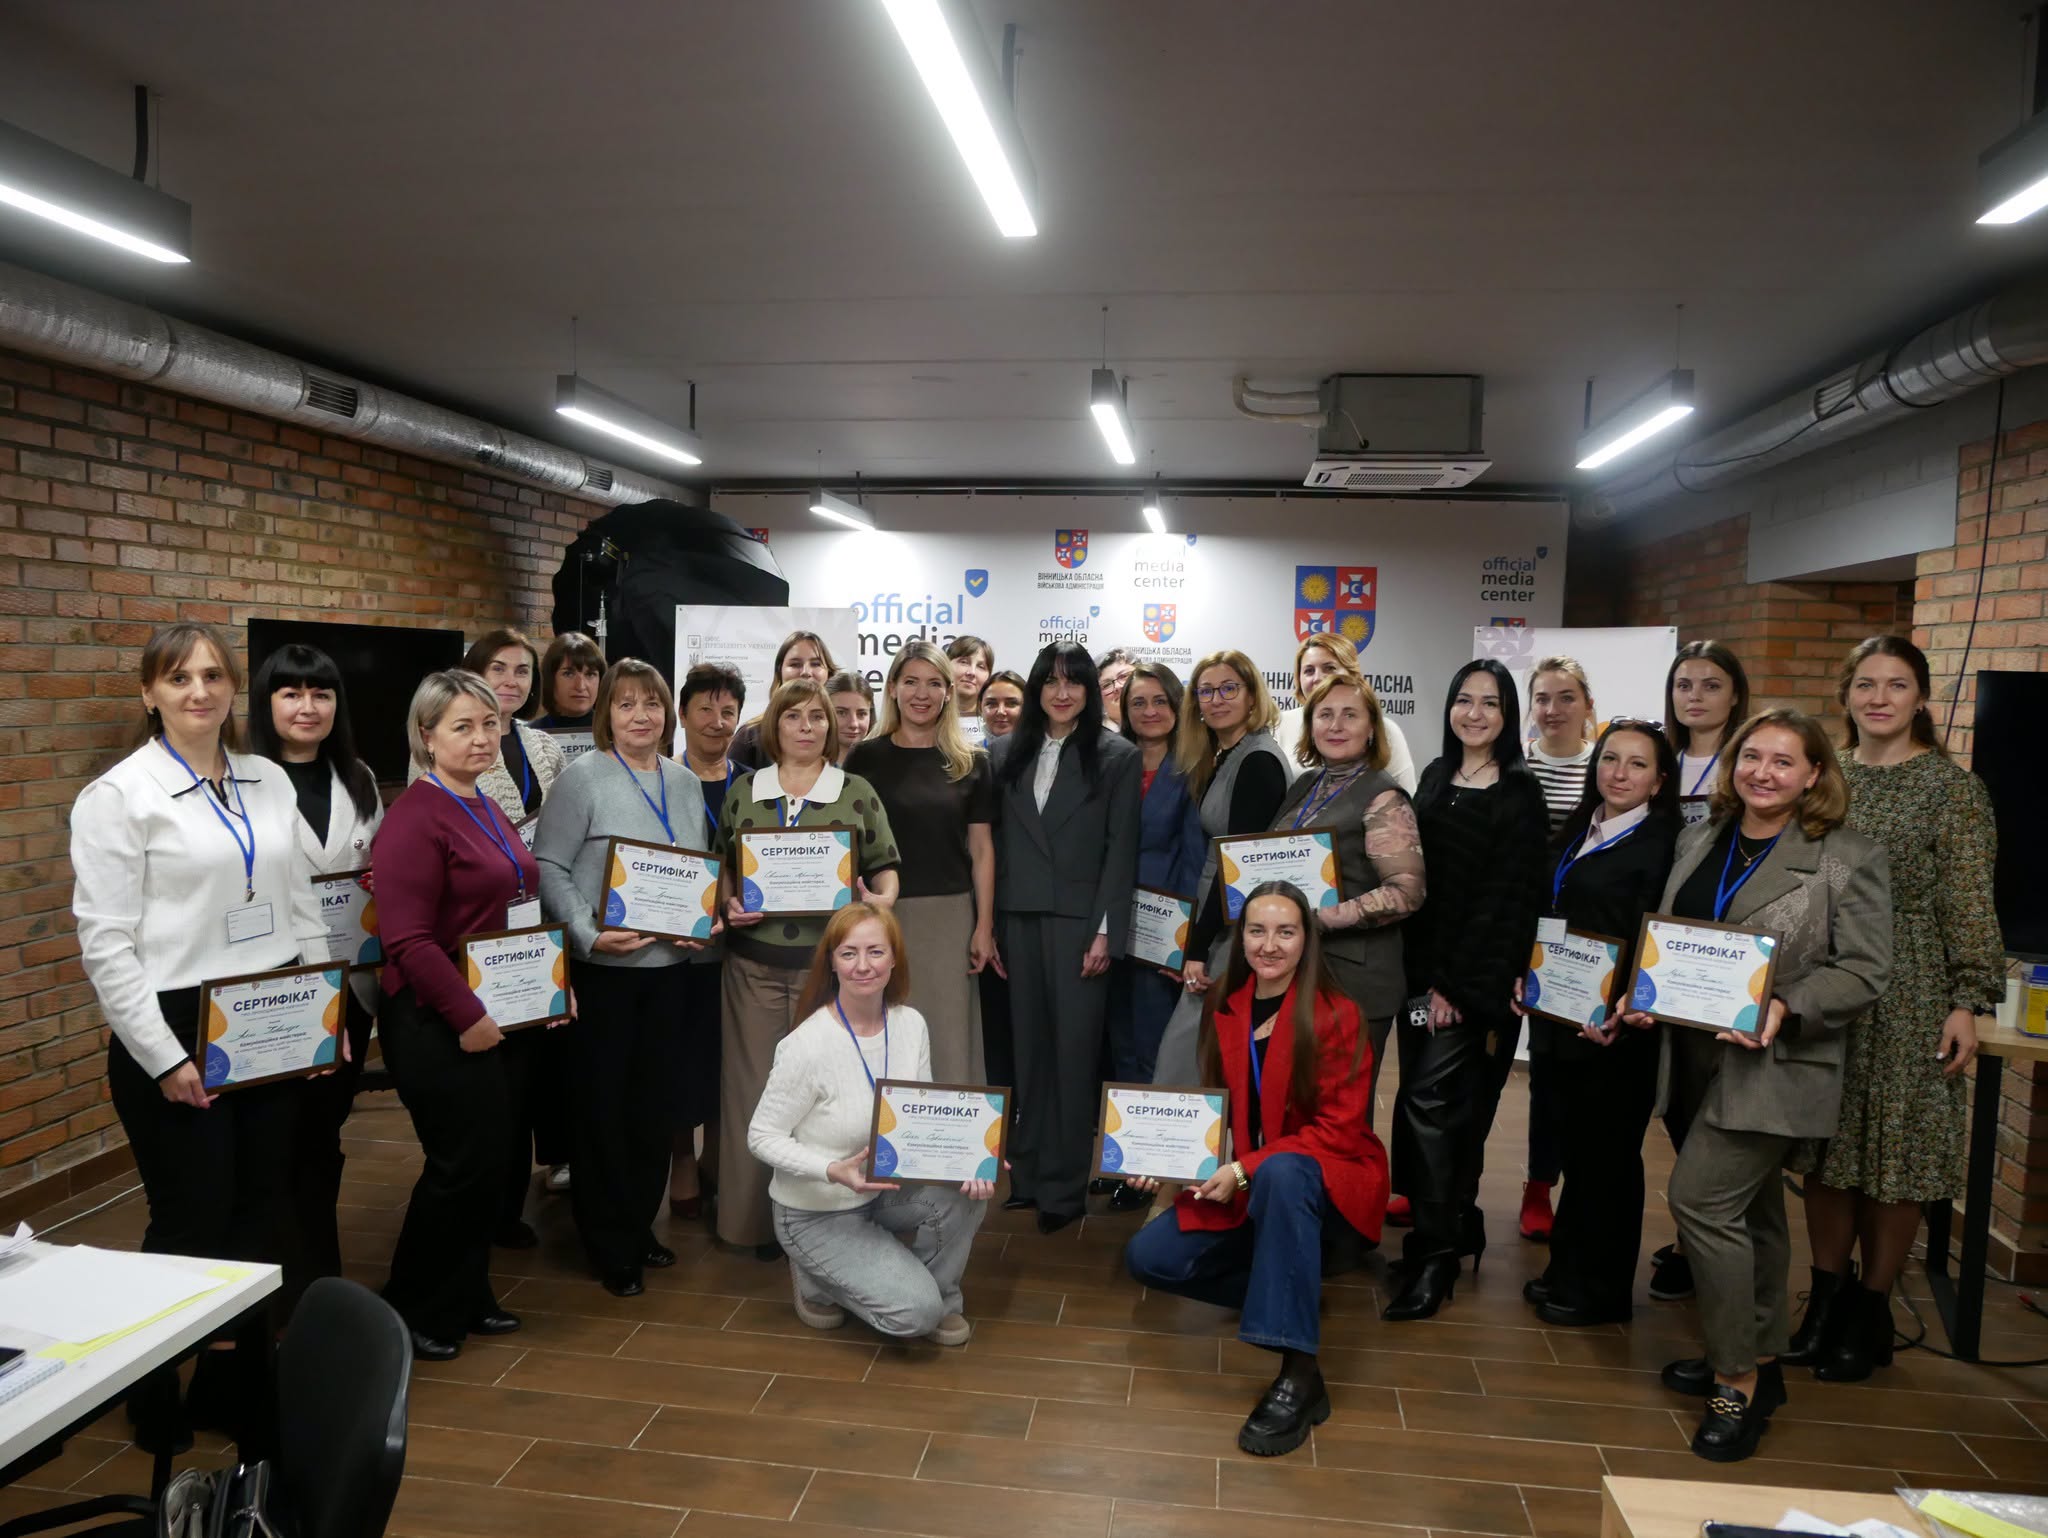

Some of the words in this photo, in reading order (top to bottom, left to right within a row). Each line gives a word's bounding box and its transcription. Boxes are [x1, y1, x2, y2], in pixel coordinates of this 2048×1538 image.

[1133, 560, 1185, 573] media
[1482, 556, 1536, 571] official
[1038, 572, 1073, 581] ВІННИЦЬКА
[1074, 572, 1104, 581] ОБЛАСНА
[1133, 576, 1185, 588] center
[1482, 572, 1535, 586] media
[1481, 589, 1535, 602] center
[850, 593, 964, 625] official
[1040, 615, 1090, 629] official
[1039, 629, 1088, 643] media
[1363, 674, 1413, 694] ЛАСНА
[761, 846, 830, 856] СЕРТИФІКАТ
[1242, 848, 1311, 864] СЕРТИФІКАТ
[632, 861, 699, 880] СЕРТИФІКАТ
[484, 948, 546, 966] СЕРТИФІКАТ
[1548, 944, 1600, 965] СЕРТИФІКАТ
[1666, 940, 1746, 961] СЕРТИФІКАТ
[233, 989, 317, 1012] СЕРТИФІКАТ
[902, 1103, 979, 1118] СЕРТИФІКАТ
[1127, 1105, 1200, 1119] СЕРТИФІКАТ
